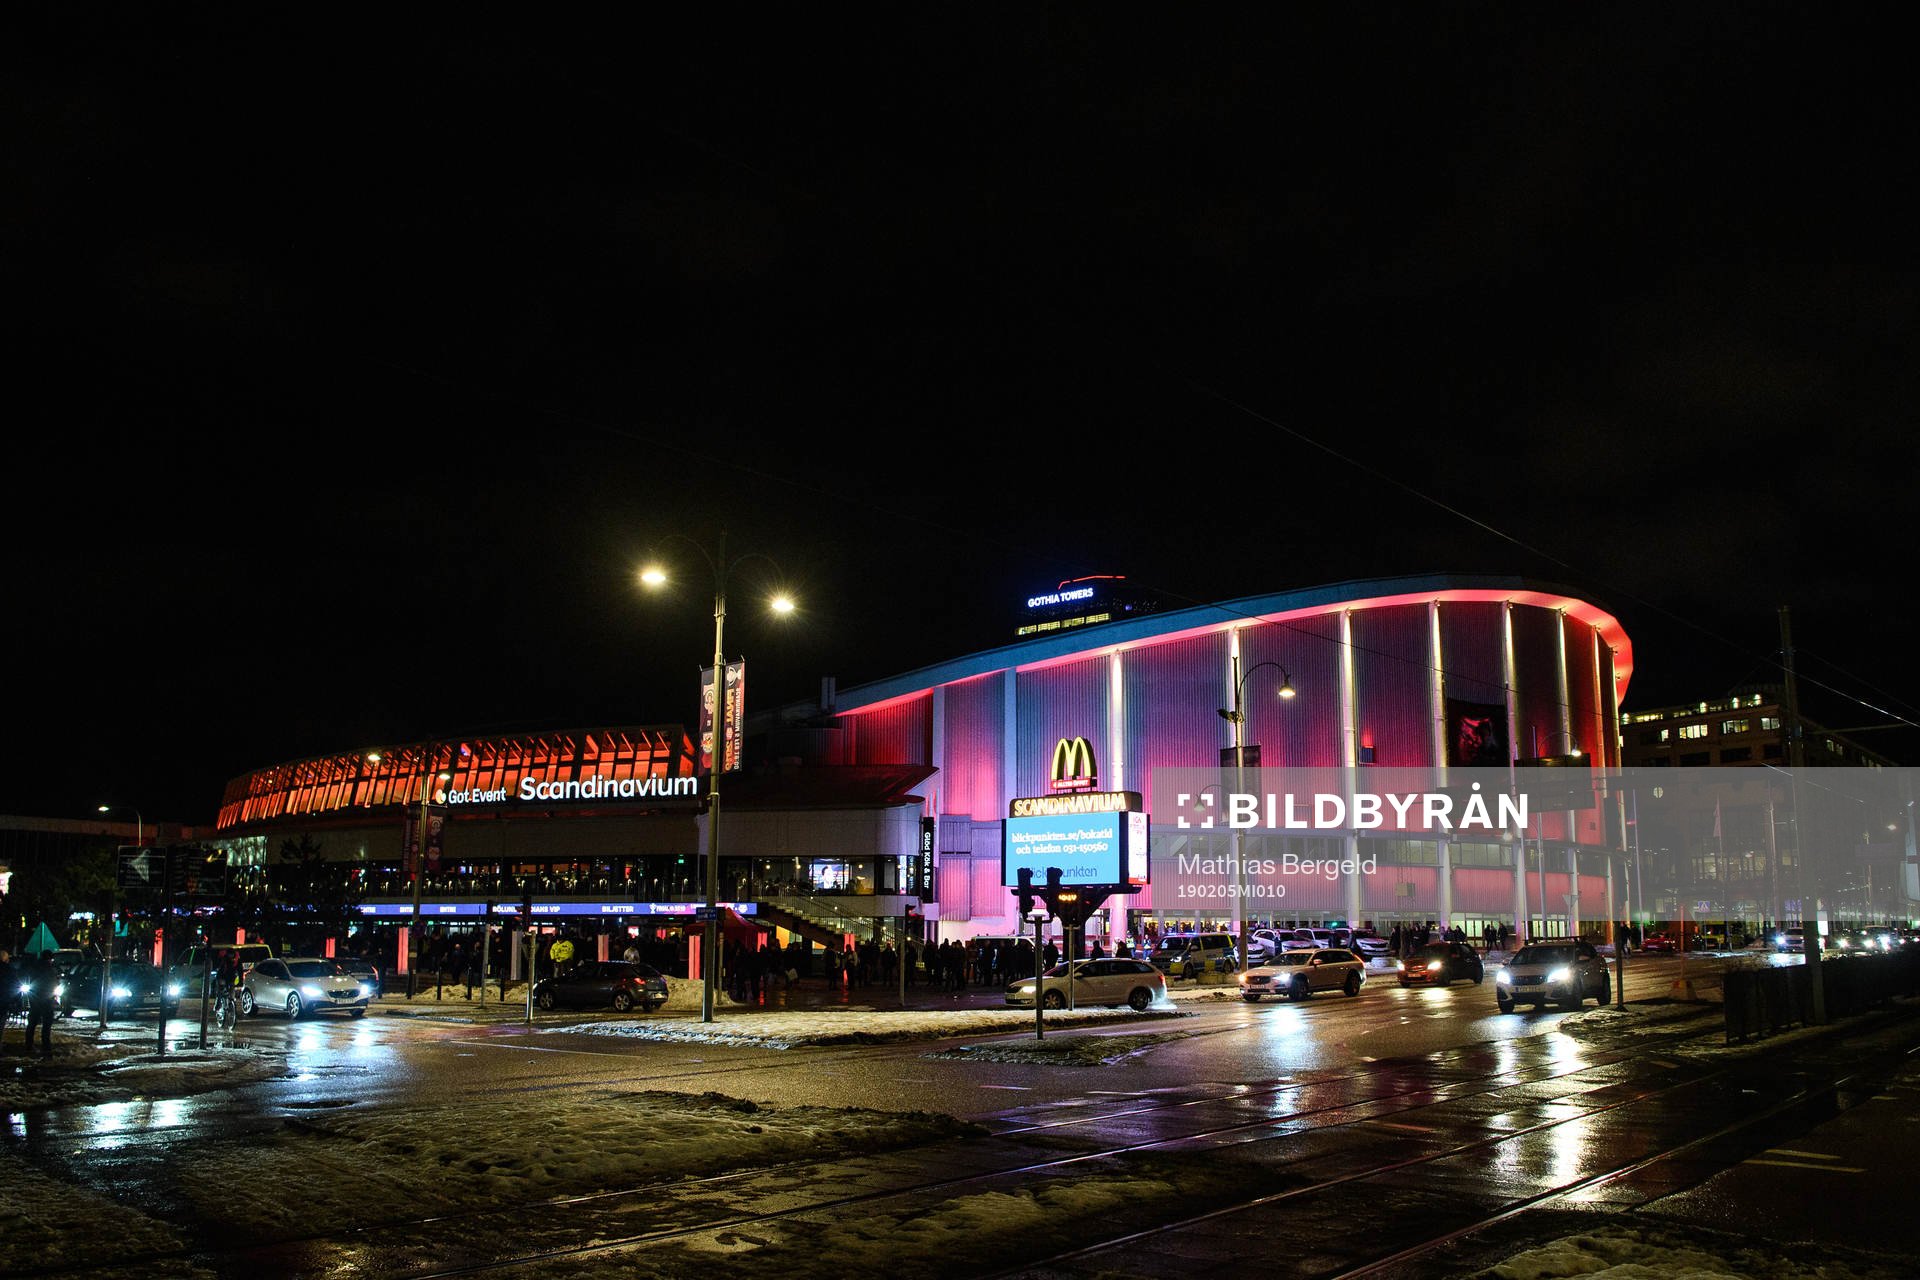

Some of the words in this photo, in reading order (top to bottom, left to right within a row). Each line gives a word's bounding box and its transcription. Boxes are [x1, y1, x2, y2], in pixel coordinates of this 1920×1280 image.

[1028, 593, 1059, 608] GOTHIA
[1060, 587, 1093, 602] TOWERS
[520, 773, 698, 801] Scandinavium
[448, 789, 469, 804] Got
[472, 787, 506, 803] Event
[1014, 793, 1127, 816] SCANDINAVIUM
[1016, 845, 1031, 855] och
[1033, 844, 1062, 854] telefon
[923, 875, 931, 888] Bar
[549, 905, 561, 913] VIP
[601, 905, 634, 913] BILJETTER
